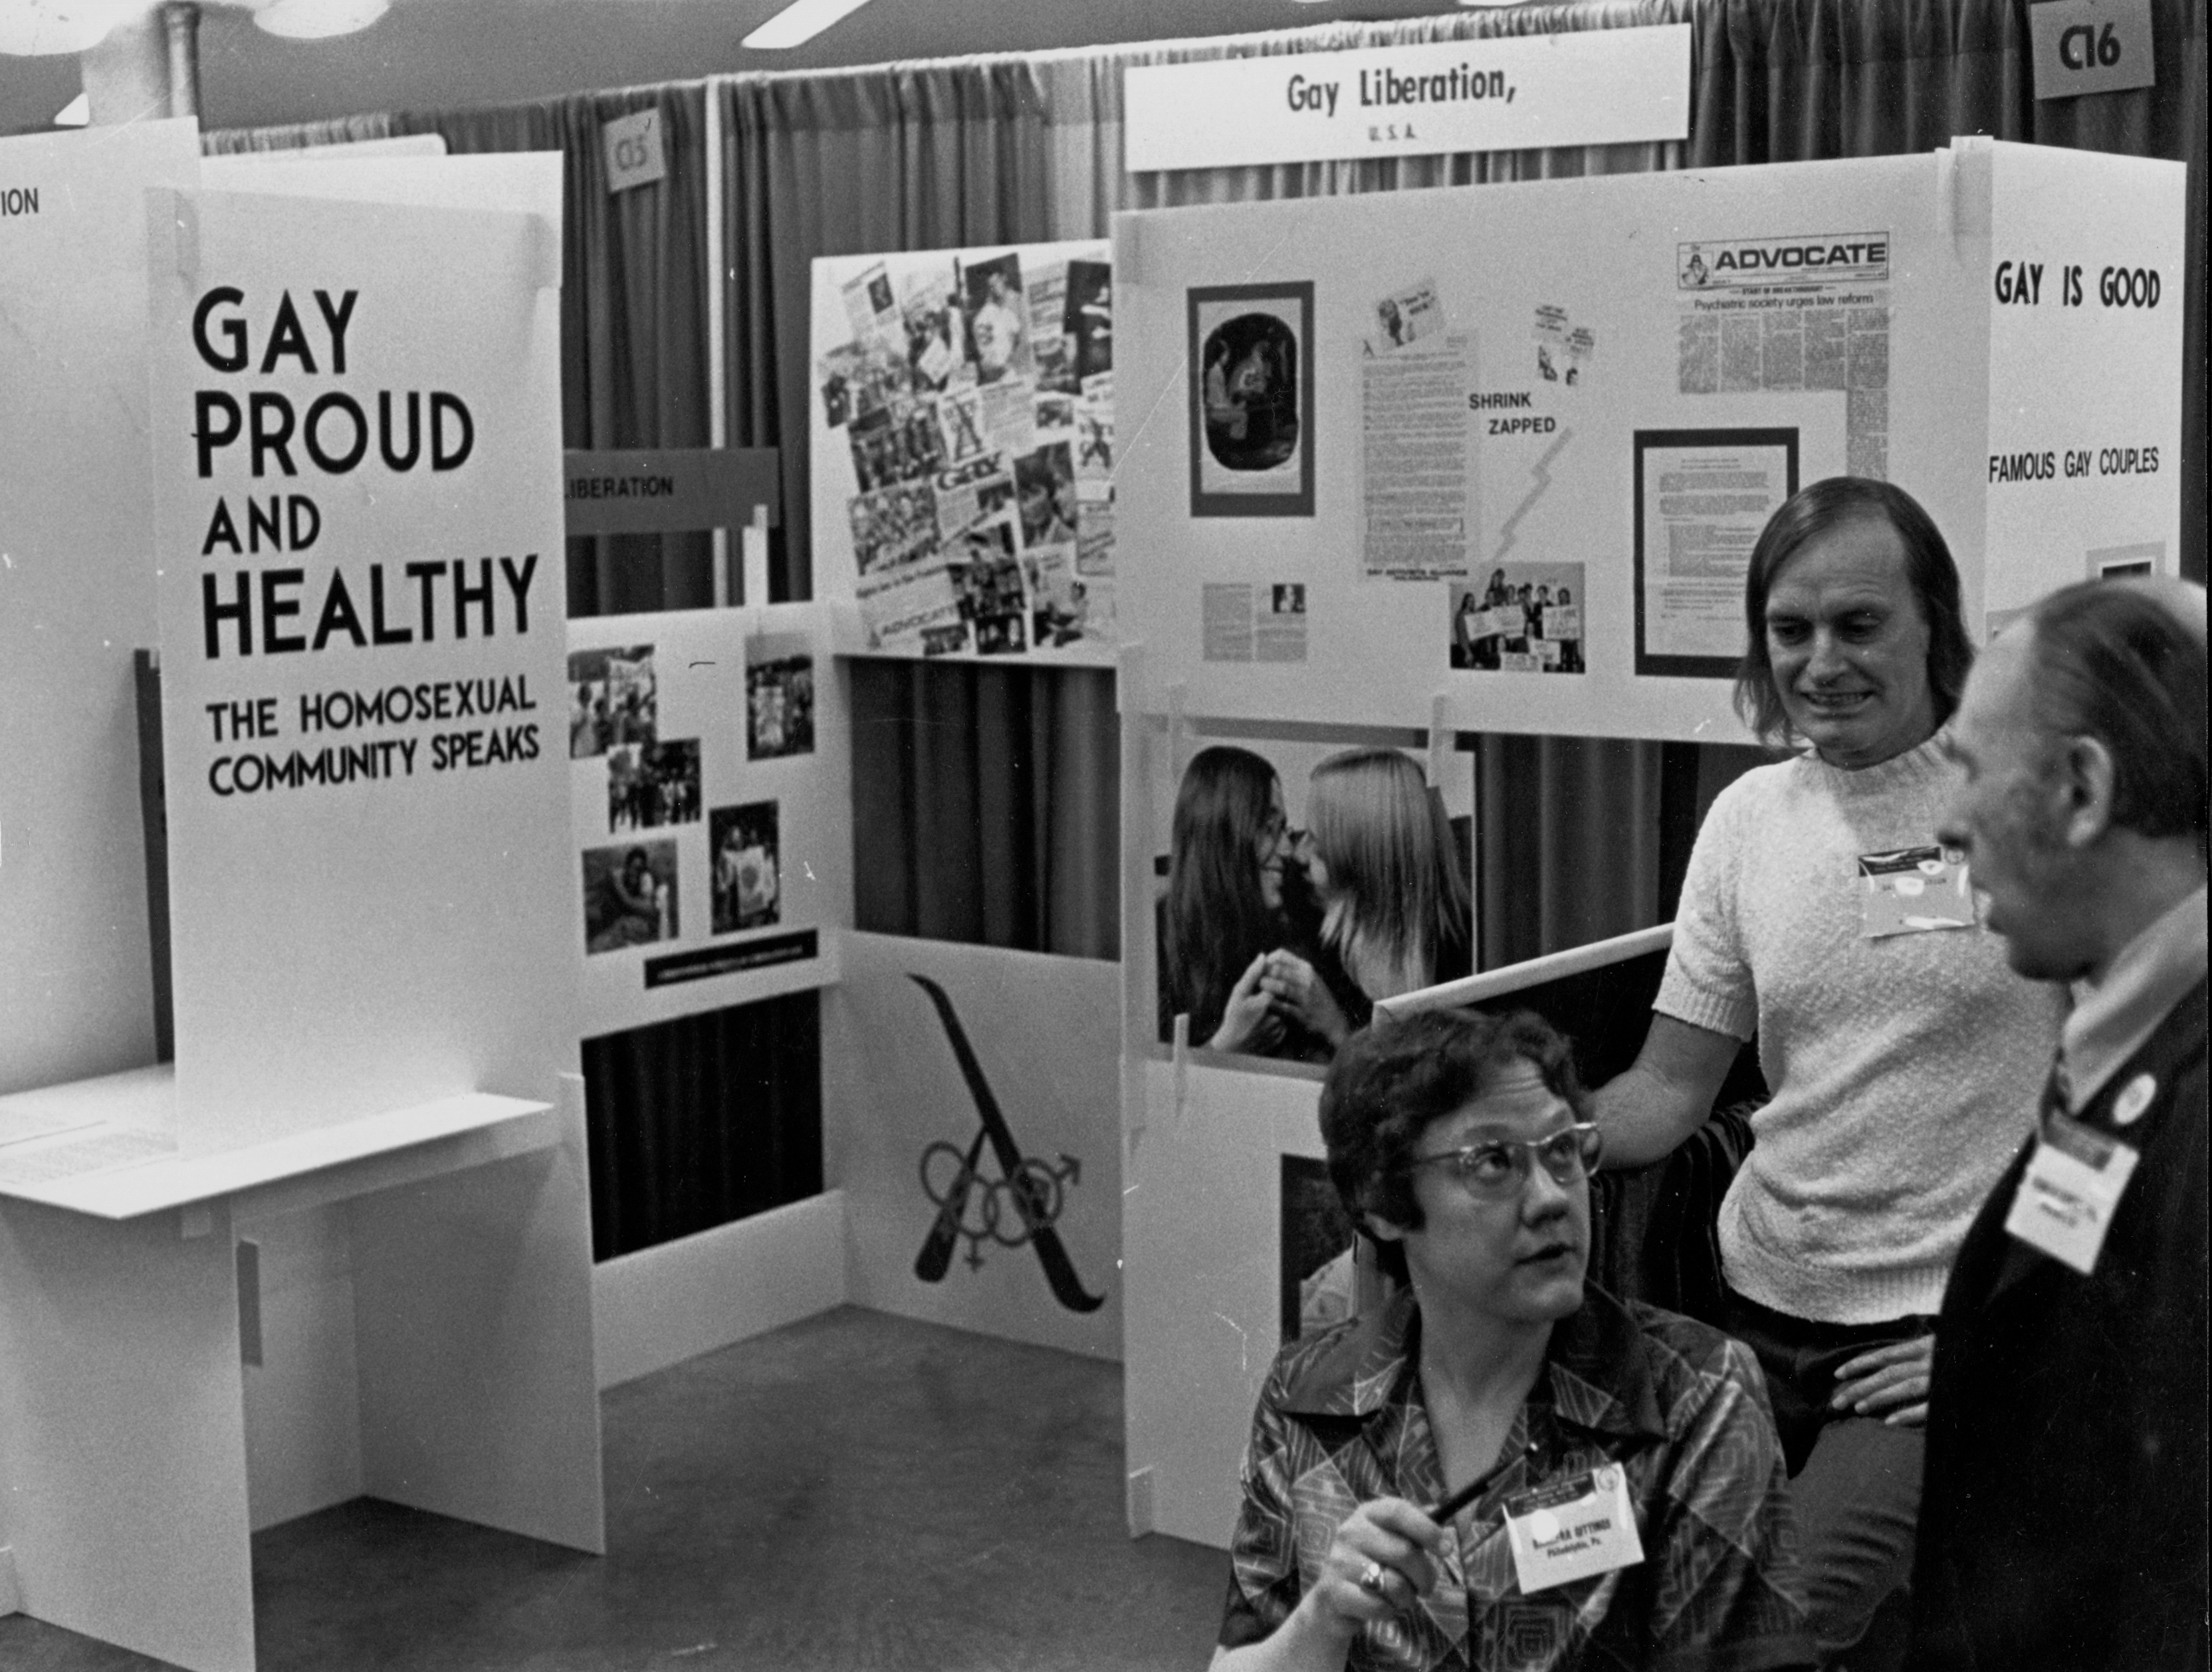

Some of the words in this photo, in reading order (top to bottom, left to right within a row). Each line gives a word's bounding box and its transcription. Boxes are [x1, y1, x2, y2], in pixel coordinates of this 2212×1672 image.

[2059, 22, 2122, 70] C16
[1287, 74, 1339, 118] Gay
[1360, 62, 1516, 106] Liberation,
[1715, 242, 1886, 270] ADVOCATE
[1694, 298, 1746, 312] Psychiatric
[1748, 297, 1783, 309] society
[1786, 297, 1815, 309] urges
[1817, 294, 1834, 306] law
[1838, 292, 1874, 305] reform
[1995, 261, 2045, 306] GAY
[2062, 265, 2084, 307] IS
[2099, 266, 2161, 309] GOOD
[192, 286, 360, 375] GAY
[1468, 391, 1532, 411] SHRINK
[1488, 416, 1556, 435] ZAPPED
[195, 390, 475, 478] PROUD
[1989, 451, 2055, 483] FAMOUS
[2064, 450, 2092, 478] GAY
[2099, 446, 2159, 476] COUPLES
[201, 494, 321, 556] AND
[201, 554, 538, 660] HEALTHY
[205, 698, 279, 743] THE
[299, 674, 536, 734] HOMOSEXUAL
[208, 738, 419, 797] COMMUNITY
[431, 723, 540, 772] SPEAKS
